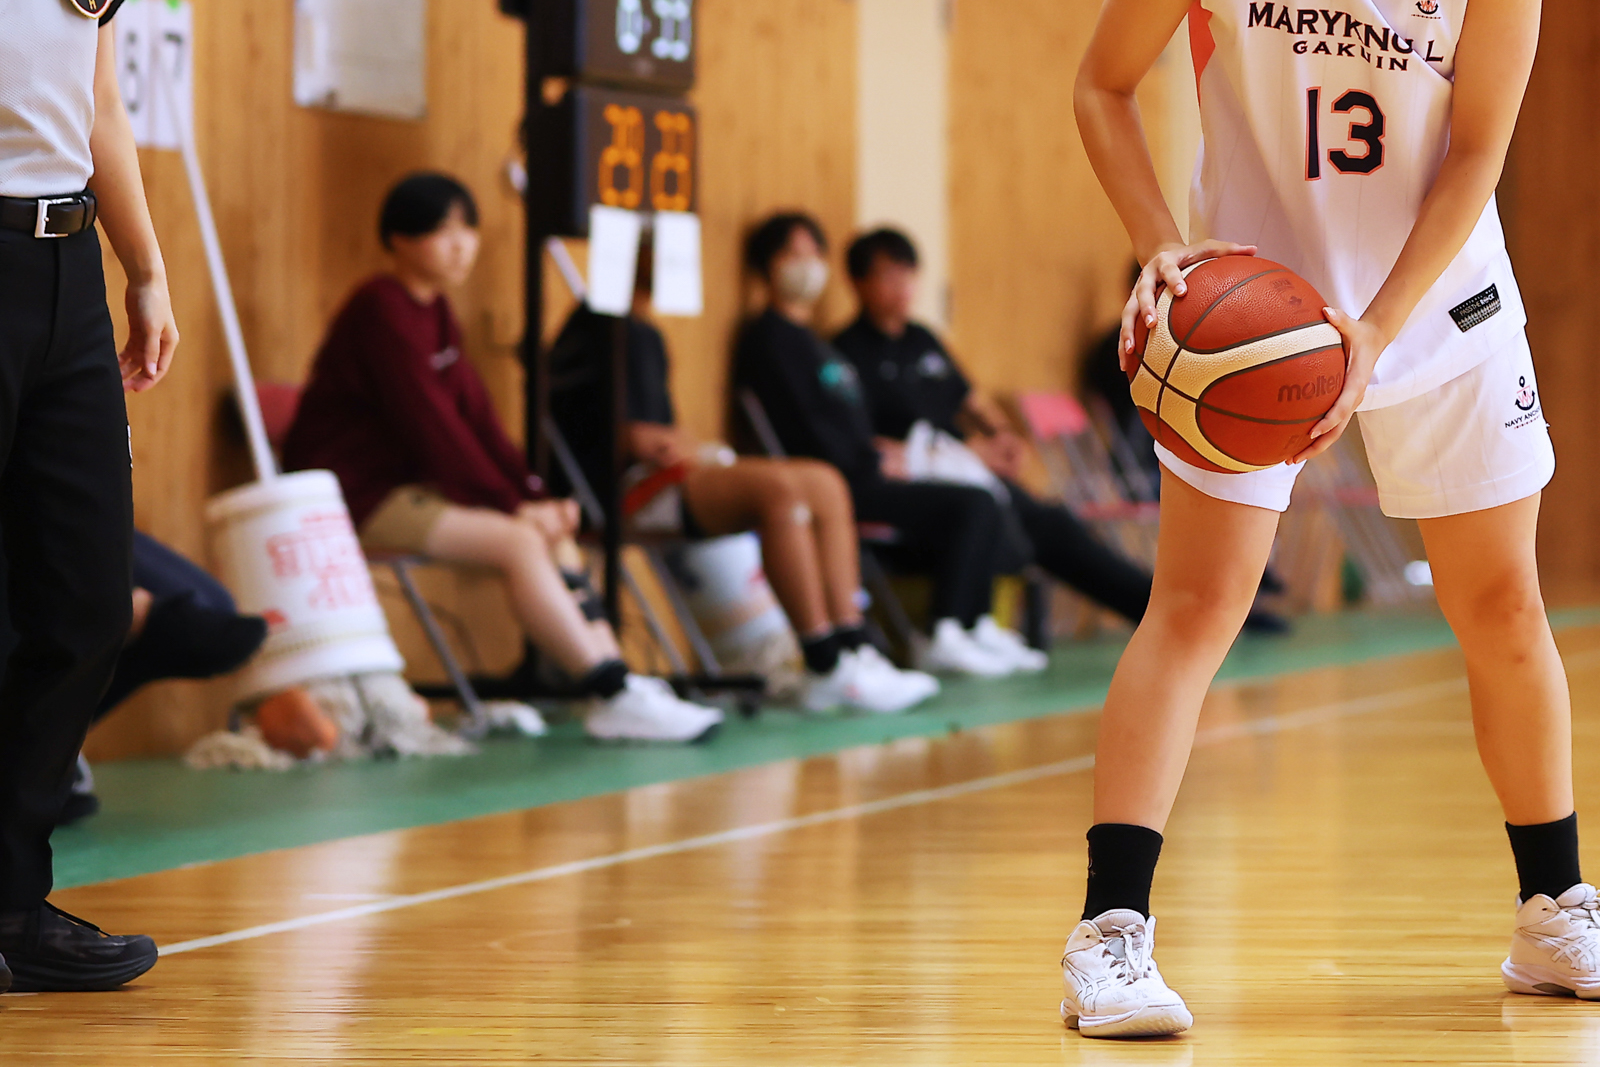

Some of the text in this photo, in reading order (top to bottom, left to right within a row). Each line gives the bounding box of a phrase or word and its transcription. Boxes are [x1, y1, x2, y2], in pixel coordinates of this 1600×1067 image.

[1247, 1, 1444, 63] MARYKNOL
[1292, 40, 1409, 71] GAKUIN
[1304, 85, 1386, 181] 13
[1504, 416, 1523, 429] NAVY
